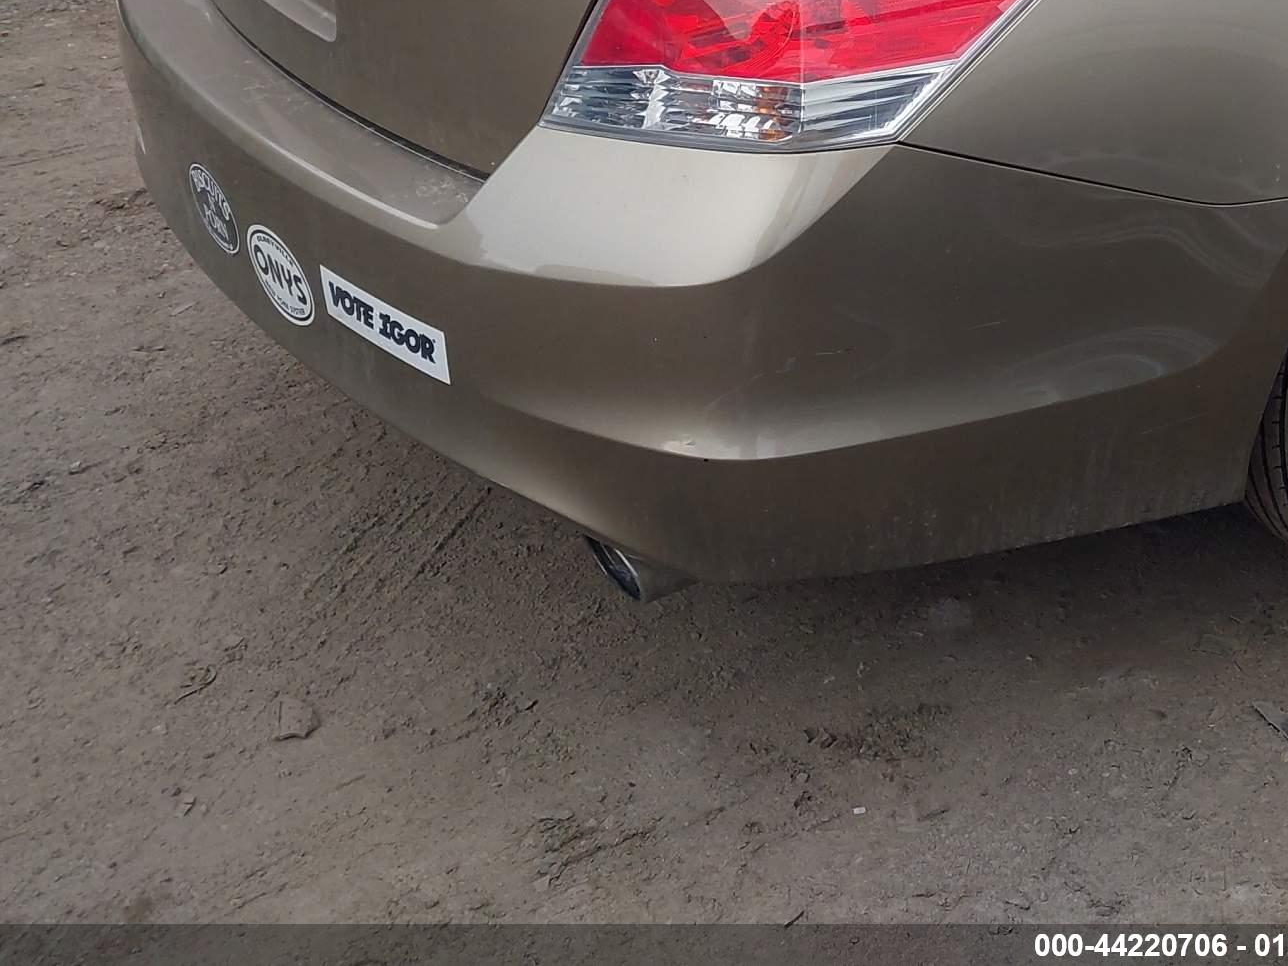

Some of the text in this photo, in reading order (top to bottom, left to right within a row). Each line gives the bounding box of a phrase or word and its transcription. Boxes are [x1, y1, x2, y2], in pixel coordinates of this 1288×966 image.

[253, 244, 308, 306] ONYS
[329, 281, 374, 330] VOTE
[379, 312, 436, 364] IGOR
